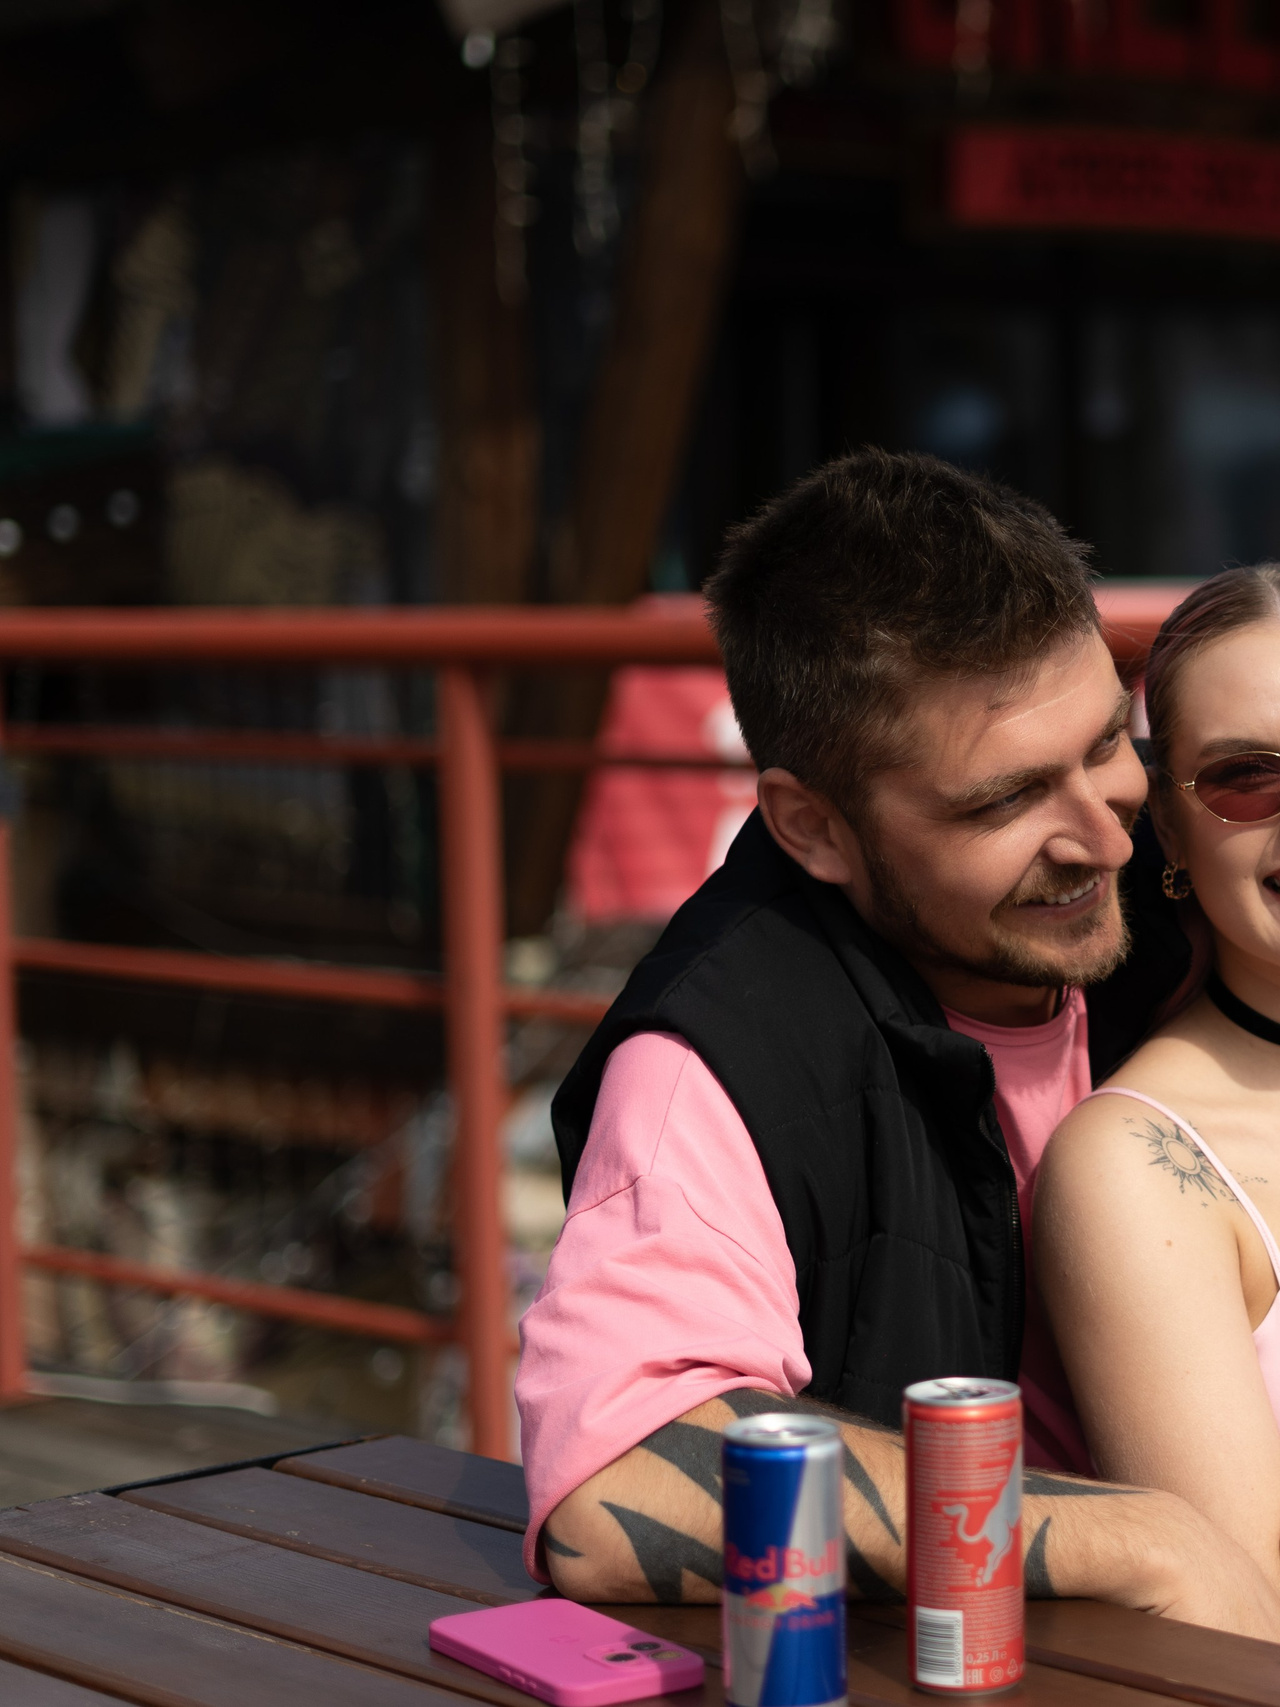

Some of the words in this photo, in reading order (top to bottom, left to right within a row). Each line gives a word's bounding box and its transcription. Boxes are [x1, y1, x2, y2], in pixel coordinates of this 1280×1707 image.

[725, 1543, 778, 1582] Red
[784, 1539, 839, 1578] Bull
[966, 1651, 989, 1665] 0,25
